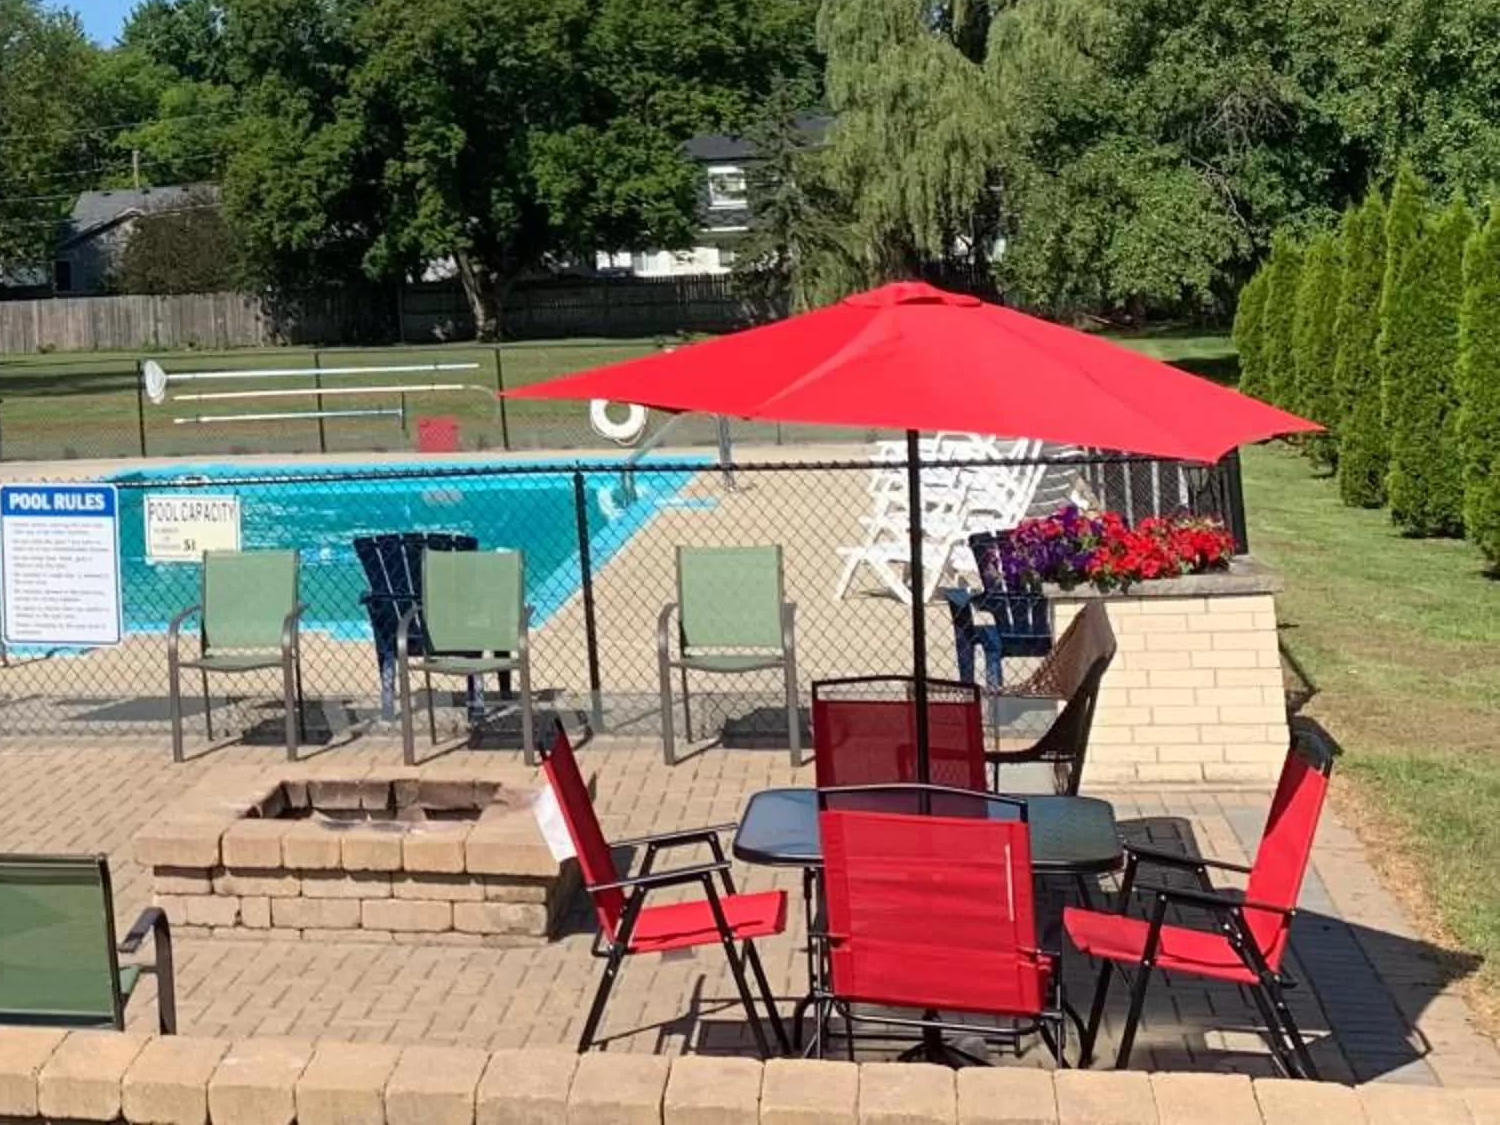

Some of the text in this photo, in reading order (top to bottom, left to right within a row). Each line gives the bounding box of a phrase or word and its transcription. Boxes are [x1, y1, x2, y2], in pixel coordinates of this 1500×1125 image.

[9, 492, 106, 511] POOL RULES
[149, 502, 233, 522] POOL CAPACITY
